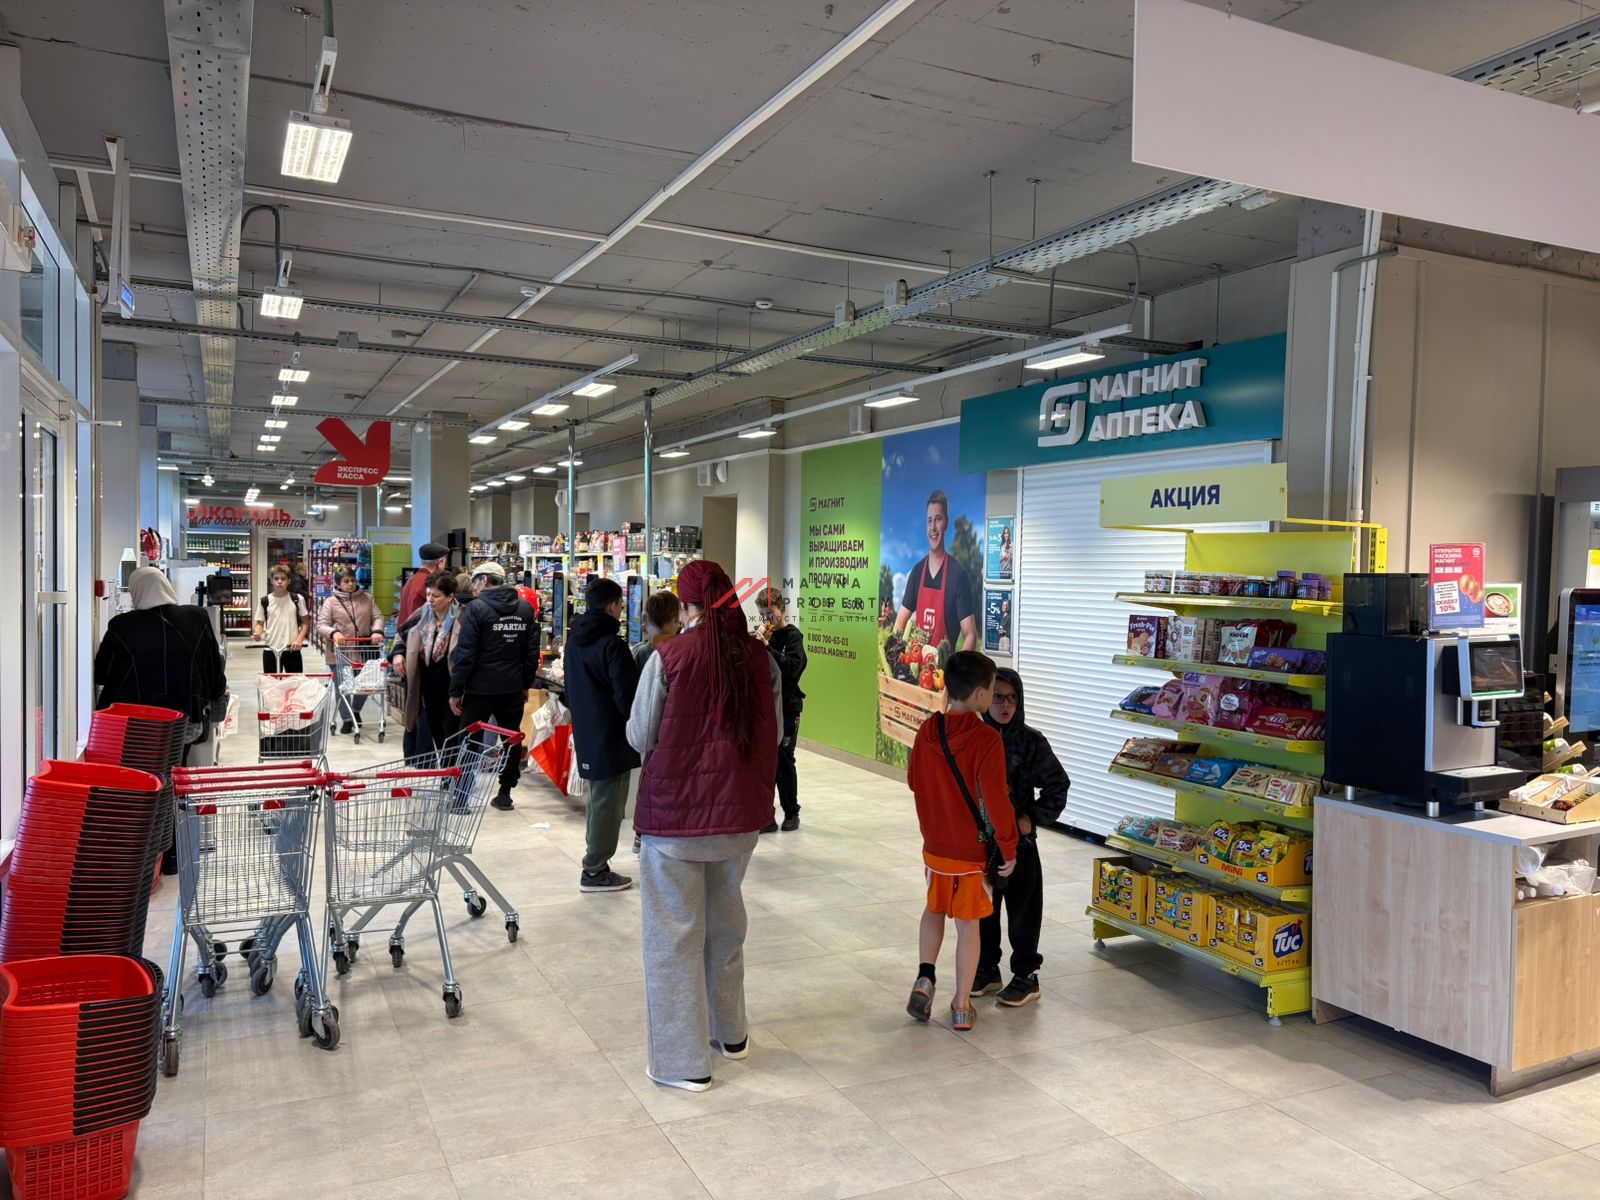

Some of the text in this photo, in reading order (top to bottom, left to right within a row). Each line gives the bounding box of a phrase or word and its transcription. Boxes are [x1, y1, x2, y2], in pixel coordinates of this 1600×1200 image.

[1089, 357, 1207, 404] МАГНИТ
[1087, 400, 1207, 442] АПТЕКА
[336, 472, 364, 480] КАССА
[337, 466, 379, 475] ЭКСПРЕСС
[818, 497, 845, 509] МАГНИТ
[1150, 484, 1220, 510] АКЦИЯ
[809, 523, 845, 536] МЫ САМИ
[809, 540, 864, 553] ВЫРАЩИВАЕМ
[808, 557, 869, 571] И ПРОИЗВОДИМ
[809, 572, 850, 586] ПРОДУКТЫ
[1439, 604, 1456, 612] 10%
[1274, 931, 1301, 953] TUC
